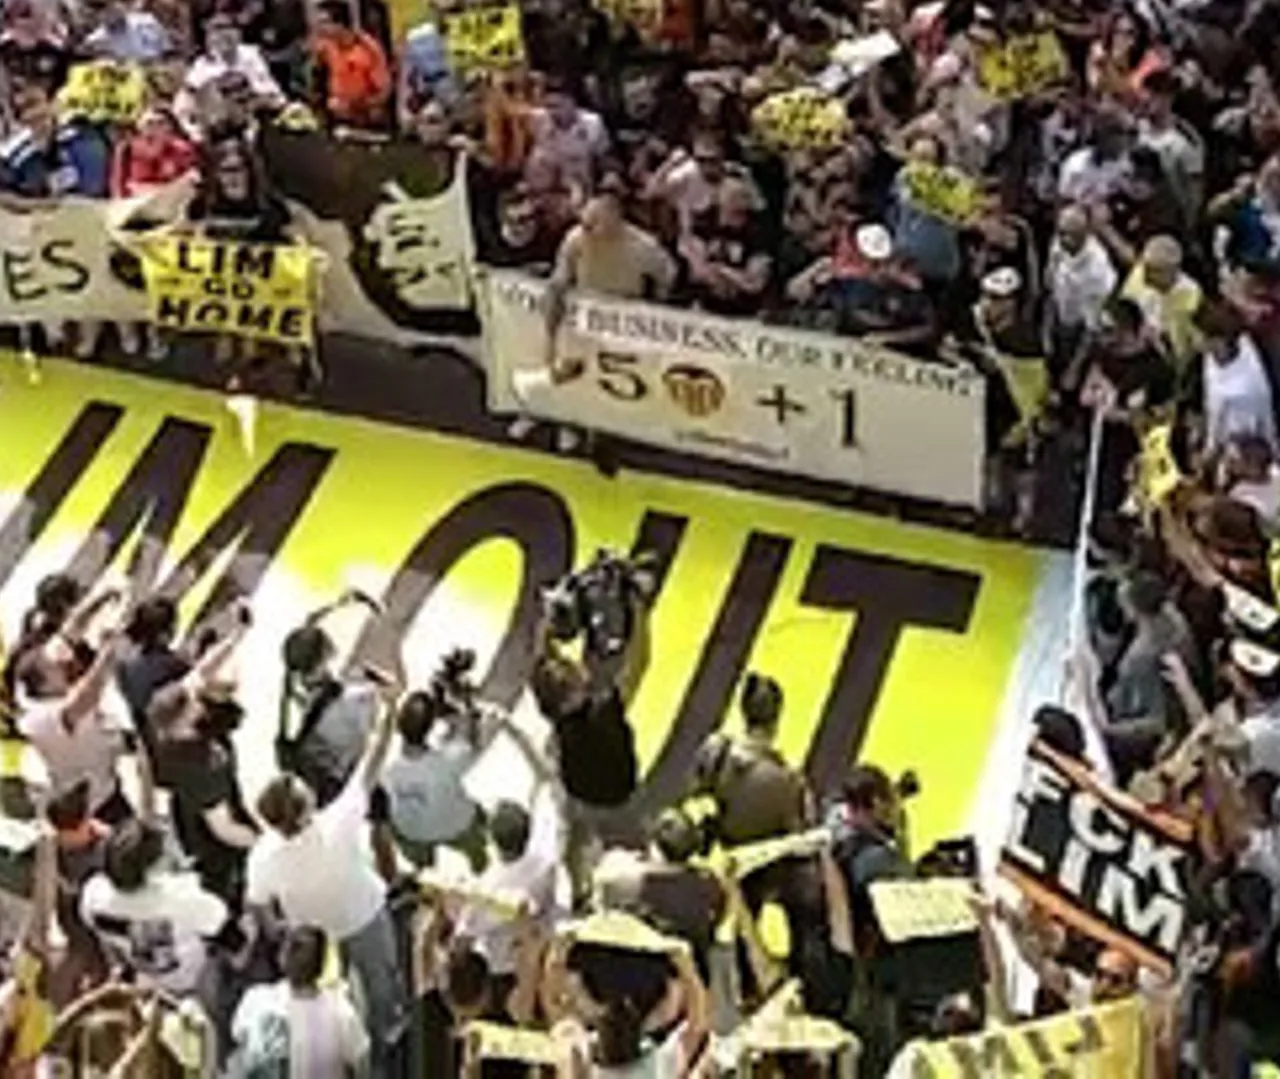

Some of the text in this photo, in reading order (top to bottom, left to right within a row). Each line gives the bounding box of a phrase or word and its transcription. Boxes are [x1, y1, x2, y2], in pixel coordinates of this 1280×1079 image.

[177, 241, 277, 279] LIM
[203, 277, 256, 301] GO
[157, 293, 304, 338] HOME
[340, 479, 983, 840] OUT
[1007, 801, 1185, 954] LIM
[1018, 760, 1187, 904] FCK
